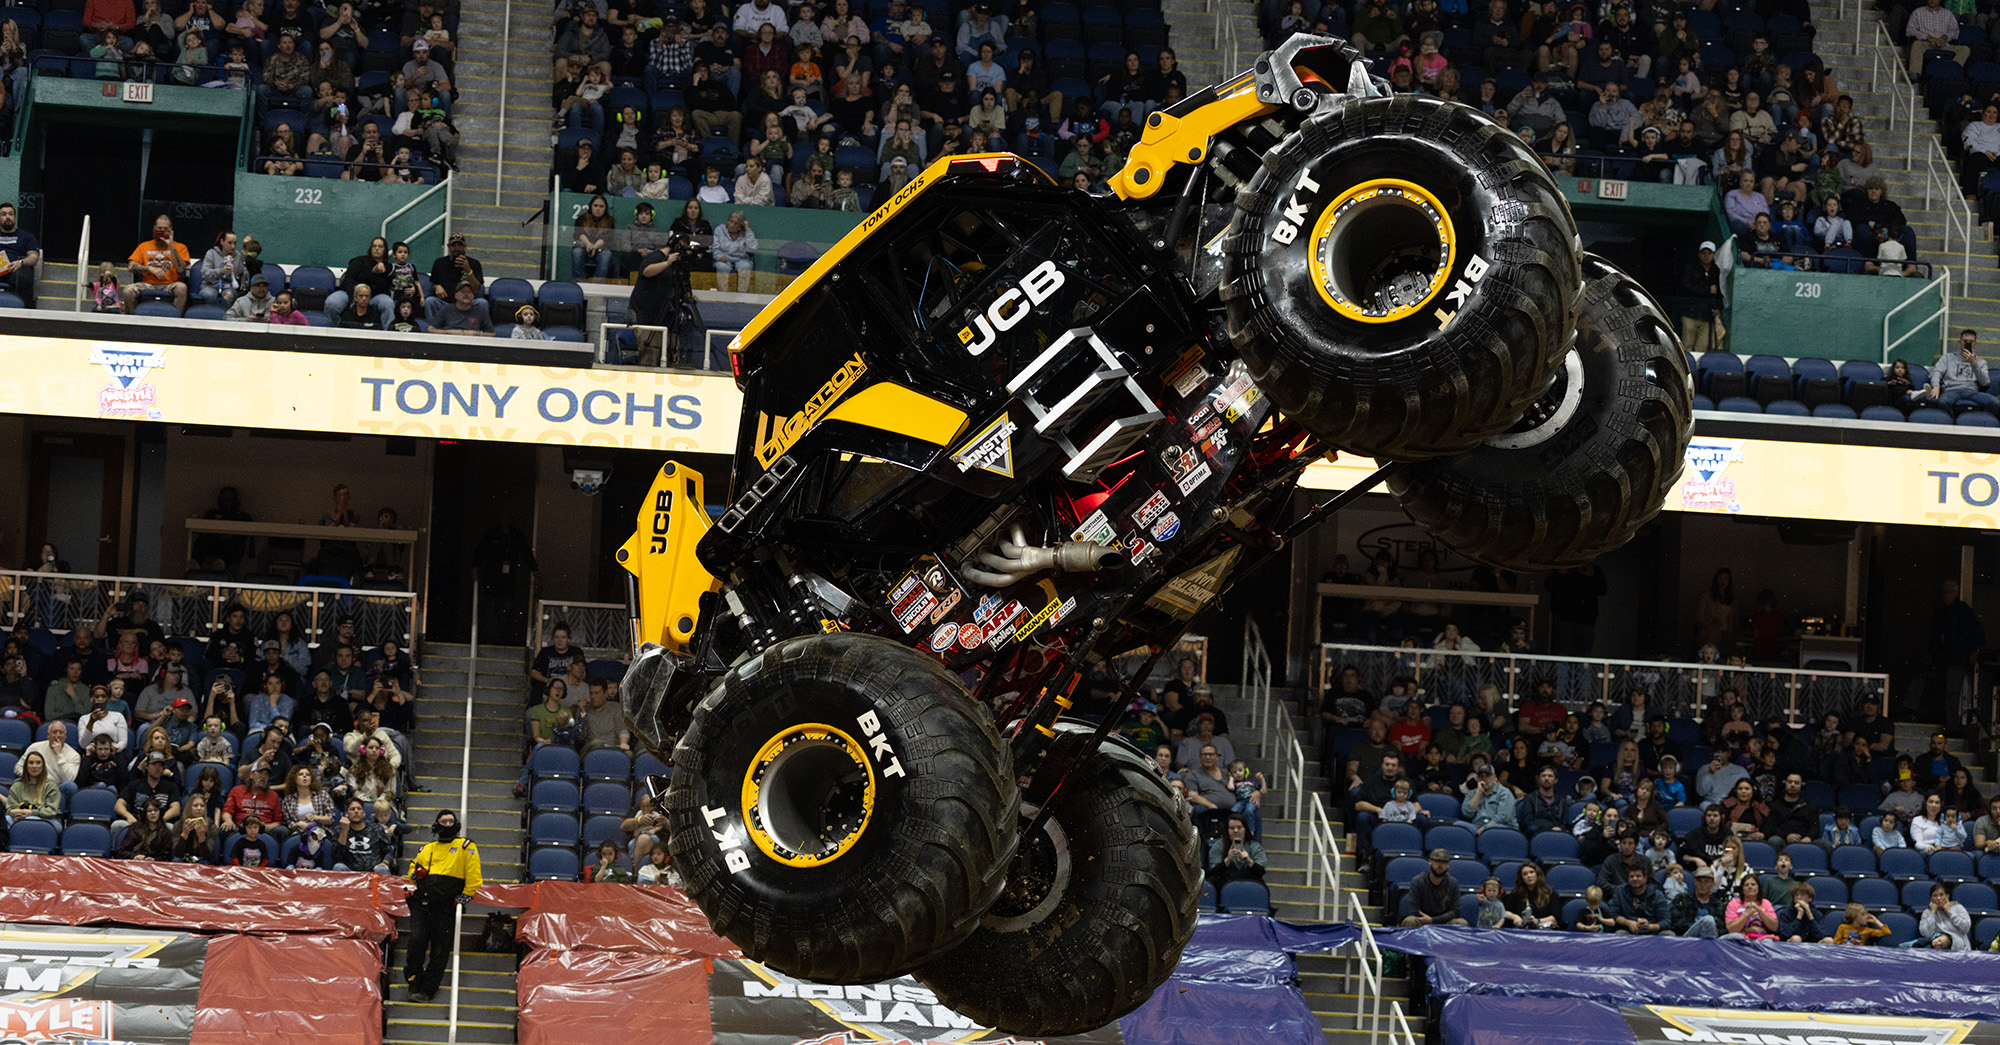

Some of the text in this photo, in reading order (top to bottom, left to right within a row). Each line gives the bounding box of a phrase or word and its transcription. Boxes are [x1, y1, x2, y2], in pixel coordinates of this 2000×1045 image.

[128, 84, 149, 100] EXIT
[294, 188, 322, 204] 232
[1604, 181, 1624, 197] EXIT
[862, 176, 925, 232] TONY OCHS
[1271, 168, 1321, 245] BKT
[1434, 254, 1490, 332] BKT
[1795, 282, 1821, 298] 230
[966, 260, 1065, 356] JCB
[361, 377, 702, 430] TONY OCHS
[1187, 406, 1210, 426] Coan
[957, 421, 1018, 473] MONSTER
[983, 440, 1010, 468] JAM
[1684, 448, 1743, 462] ONSTER
[1188, 468, 1207, 486] OPTIMA
[650, 490, 673, 554] JCB
[1145, 499, 1165, 519] ROD
[1082, 513, 1103, 533] NORTHERN
[1157, 516, 1175, 535] LUCAS
[893, 583, 925, 616] DERALE
[1167, 576, 1216, 603] MONSTER
[901, 598, 929, 627] LINCOLN
[911, 601, 935, 626] WELDERS
[975, 593, 1000, 618] SYSTEM
[982, 599, 1018, 640] ARP
[1017, 600, 1059, 640] MAGNAFLOW
[934, 625, 956, 647] TOTAL SEAL
[990, 623, 1017, 648] Holley
[856, 709, 906, 778] BKT
[700, 804, 751, 874] BKT
